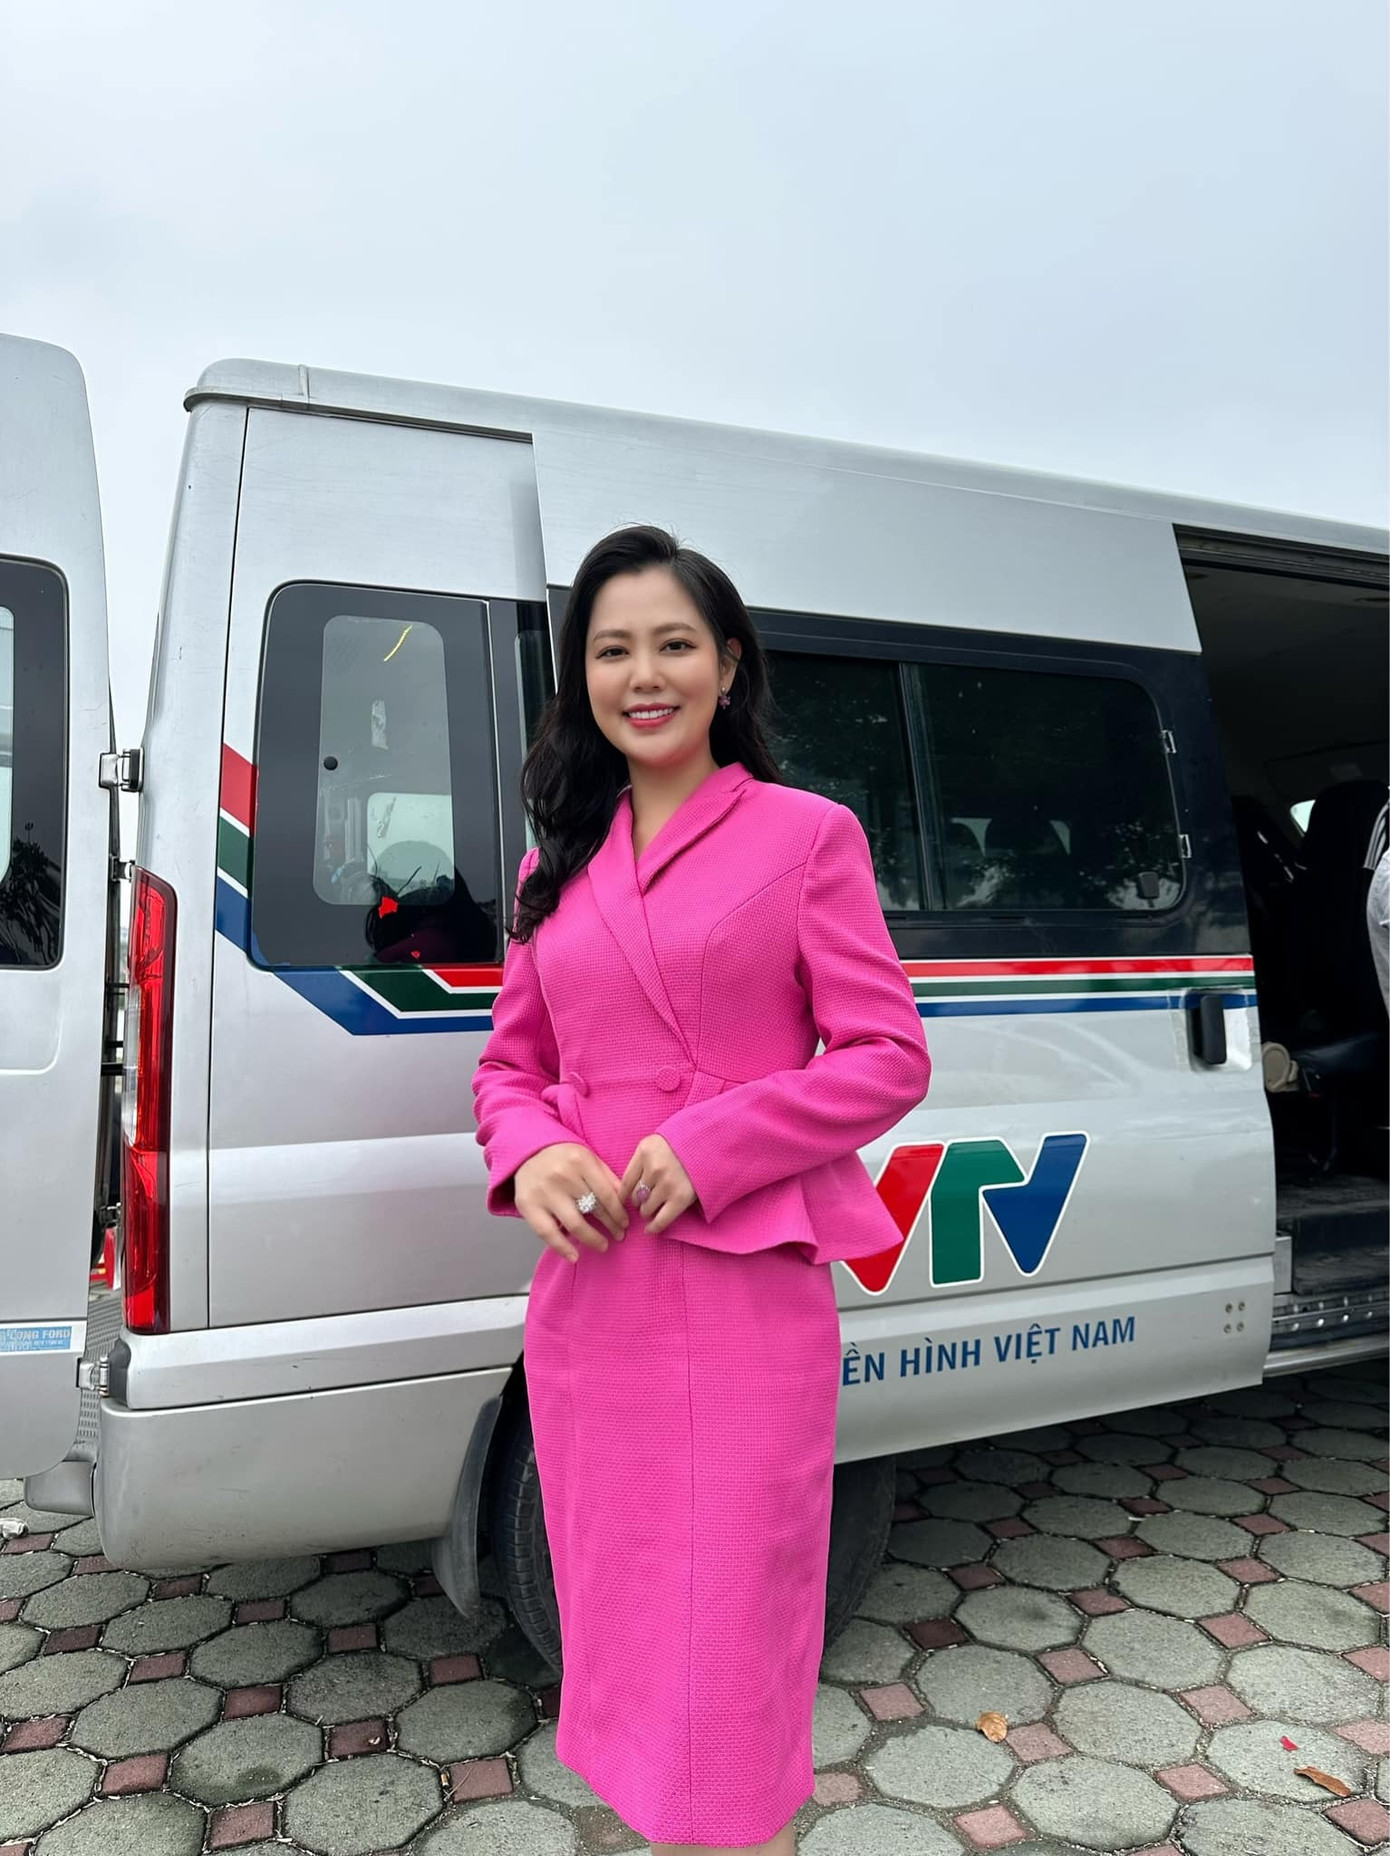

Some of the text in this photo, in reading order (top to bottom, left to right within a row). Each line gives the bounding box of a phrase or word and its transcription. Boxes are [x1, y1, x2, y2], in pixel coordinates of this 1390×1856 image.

[42, 1329, 70, 1339] FORD
[842, 1316, 1135, 1386] ỀN HÌNH VIỆT NAM
